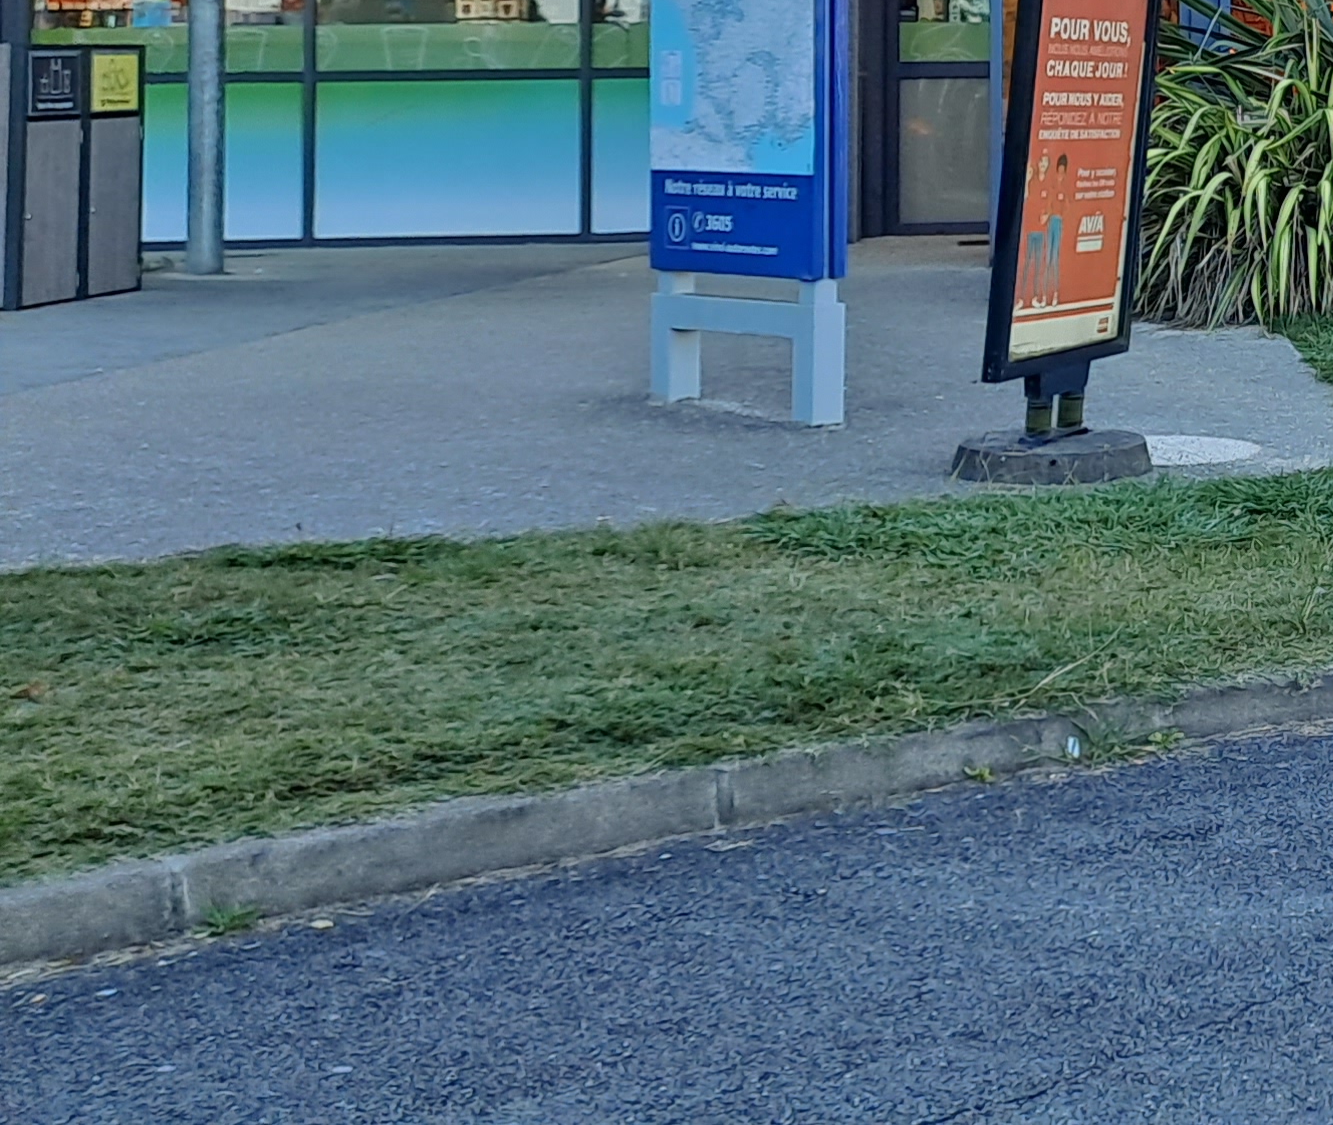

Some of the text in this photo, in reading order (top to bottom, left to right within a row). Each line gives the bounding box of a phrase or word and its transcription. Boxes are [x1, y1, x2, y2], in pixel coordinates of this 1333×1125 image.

[1050, 17, 1132, 47] POUR VOUS,
[1046, 59, 1095, 78] CHAQUE
[1042, 92, 1067, 106] POUR
[1093, 93, 1099, 106] Y
[763, 182, 798, 200] service
